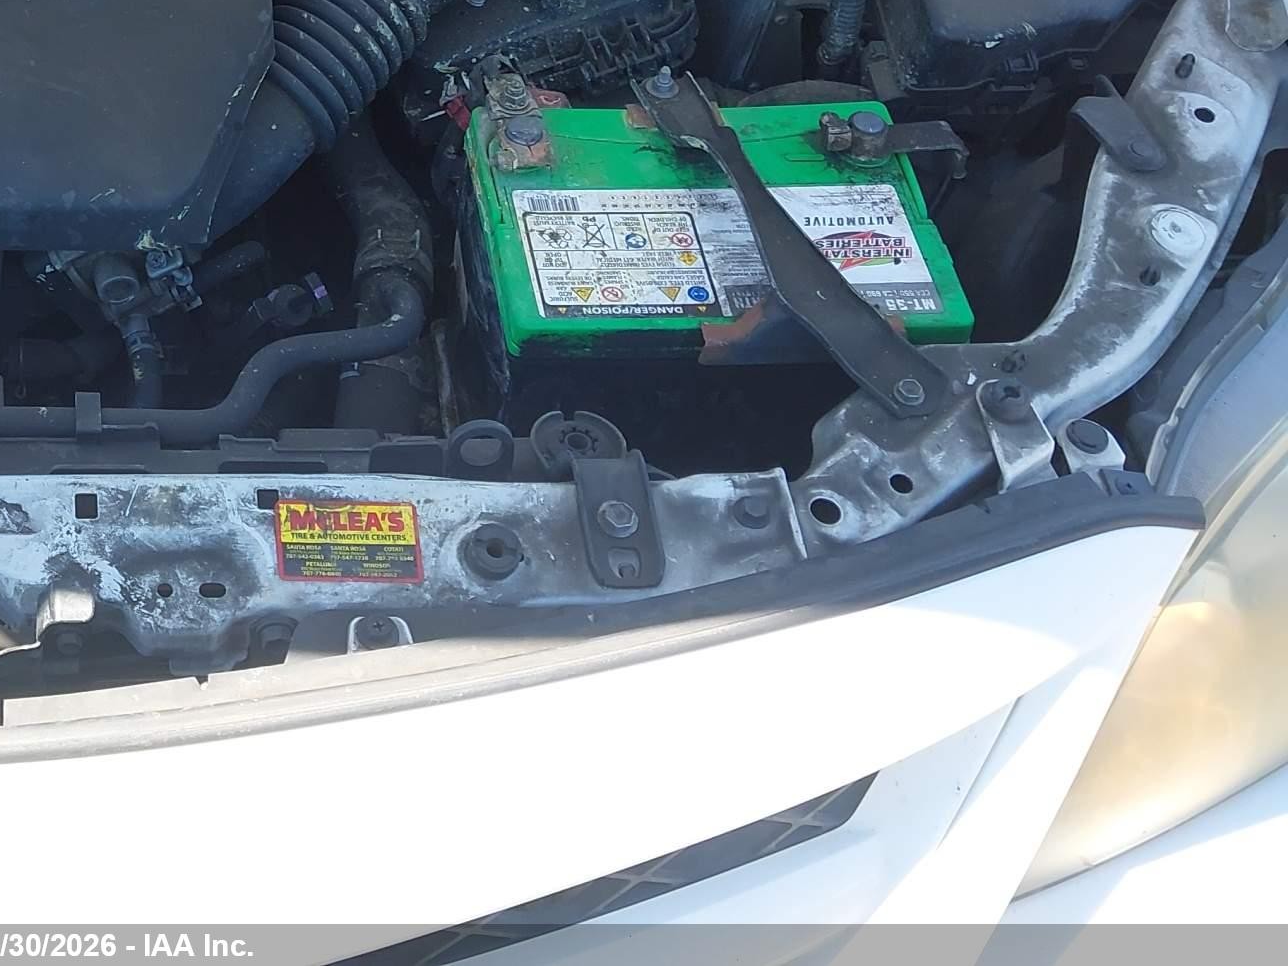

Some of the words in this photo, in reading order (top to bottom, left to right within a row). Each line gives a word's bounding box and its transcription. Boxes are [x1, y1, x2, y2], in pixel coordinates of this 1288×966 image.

[803, 216, 894, 226] AUTOMOTIVE
[815, 238, 902, 248] BATTERIES
[822, 249, 910, 258] INTERSTAT
[582, 305, 684, 314] DANGER/POISON
[885, 298, 937, 311] MT-35
